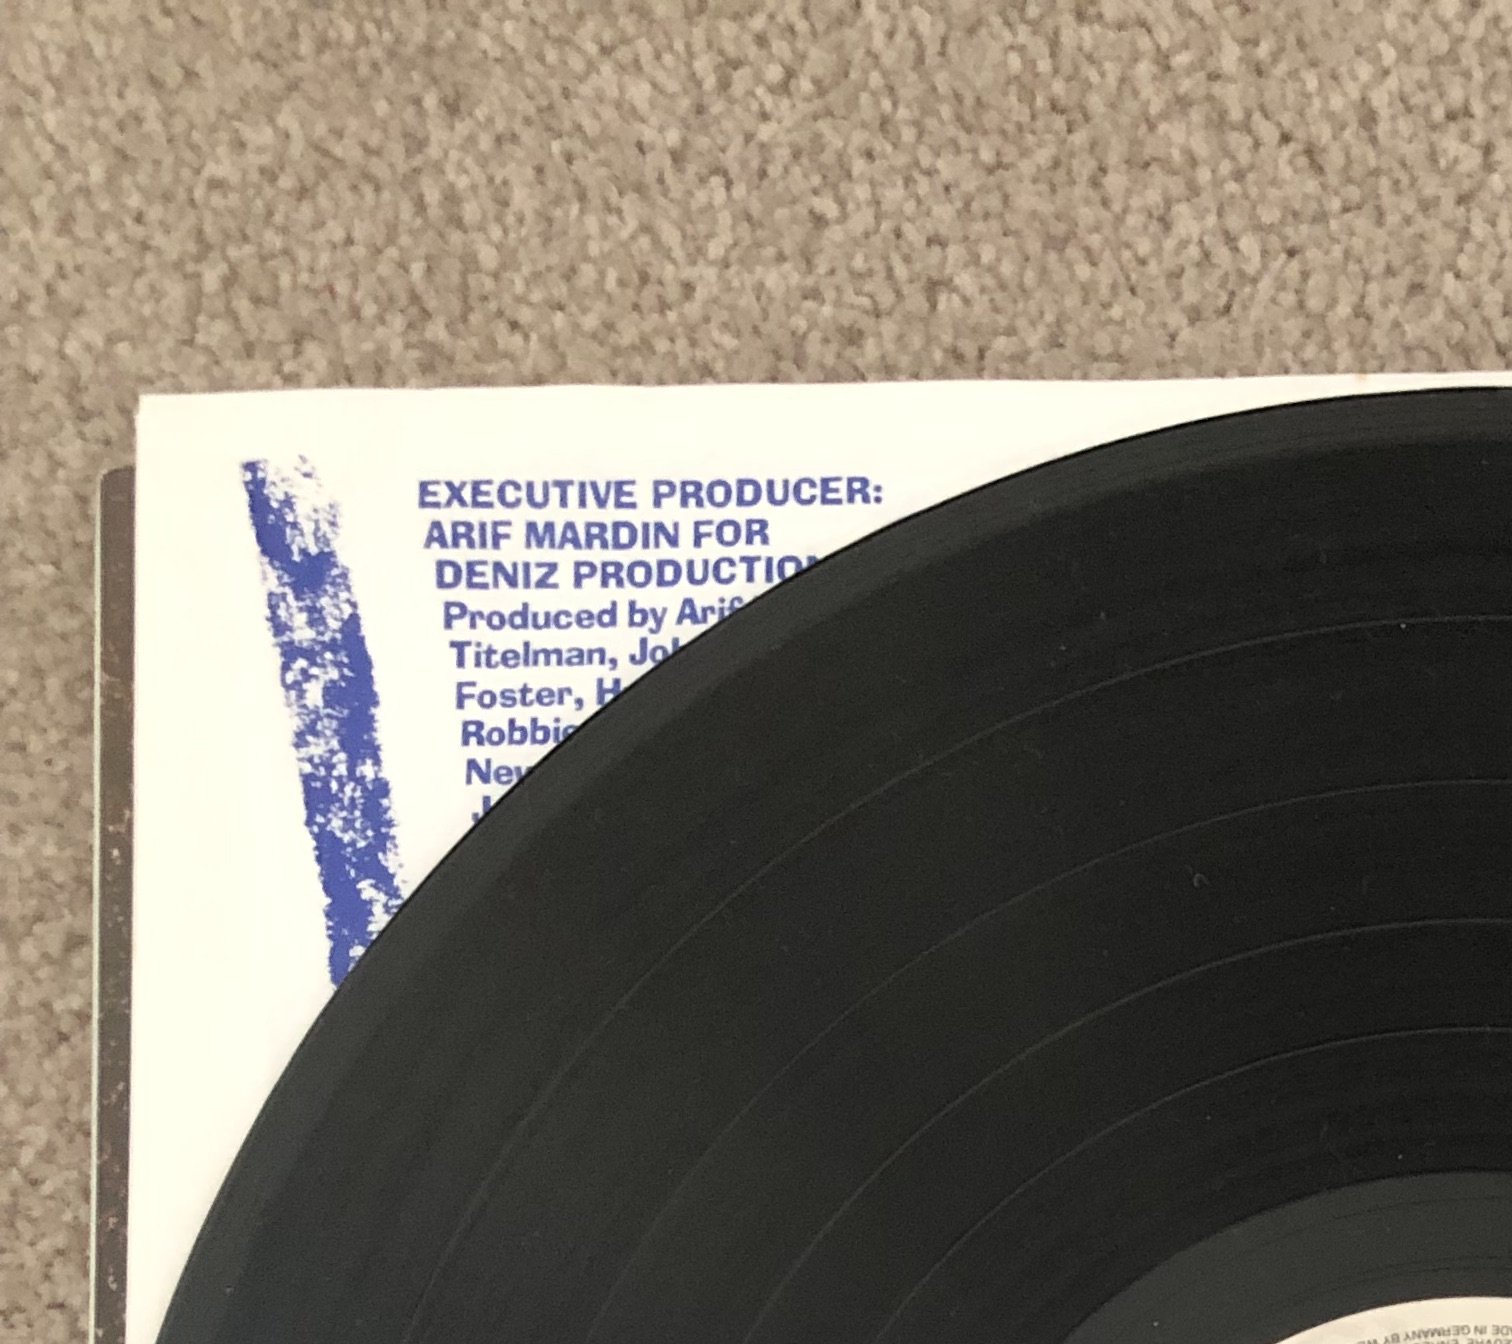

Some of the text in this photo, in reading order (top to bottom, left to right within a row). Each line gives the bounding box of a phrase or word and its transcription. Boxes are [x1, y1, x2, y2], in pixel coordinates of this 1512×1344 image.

[418, 476, 884, 510] EXECUTIVE PRODUCER:
[423, 518, 770, 550] ARIF MARDIN FOR
[435, 560, 560, 590] DENIZ
[443, 600, 617, 630] Produced
[628, 598, 668, 634] by
[449, 639, 618, 671] Titelman,
[455, 680, 585, 711] Foster,
